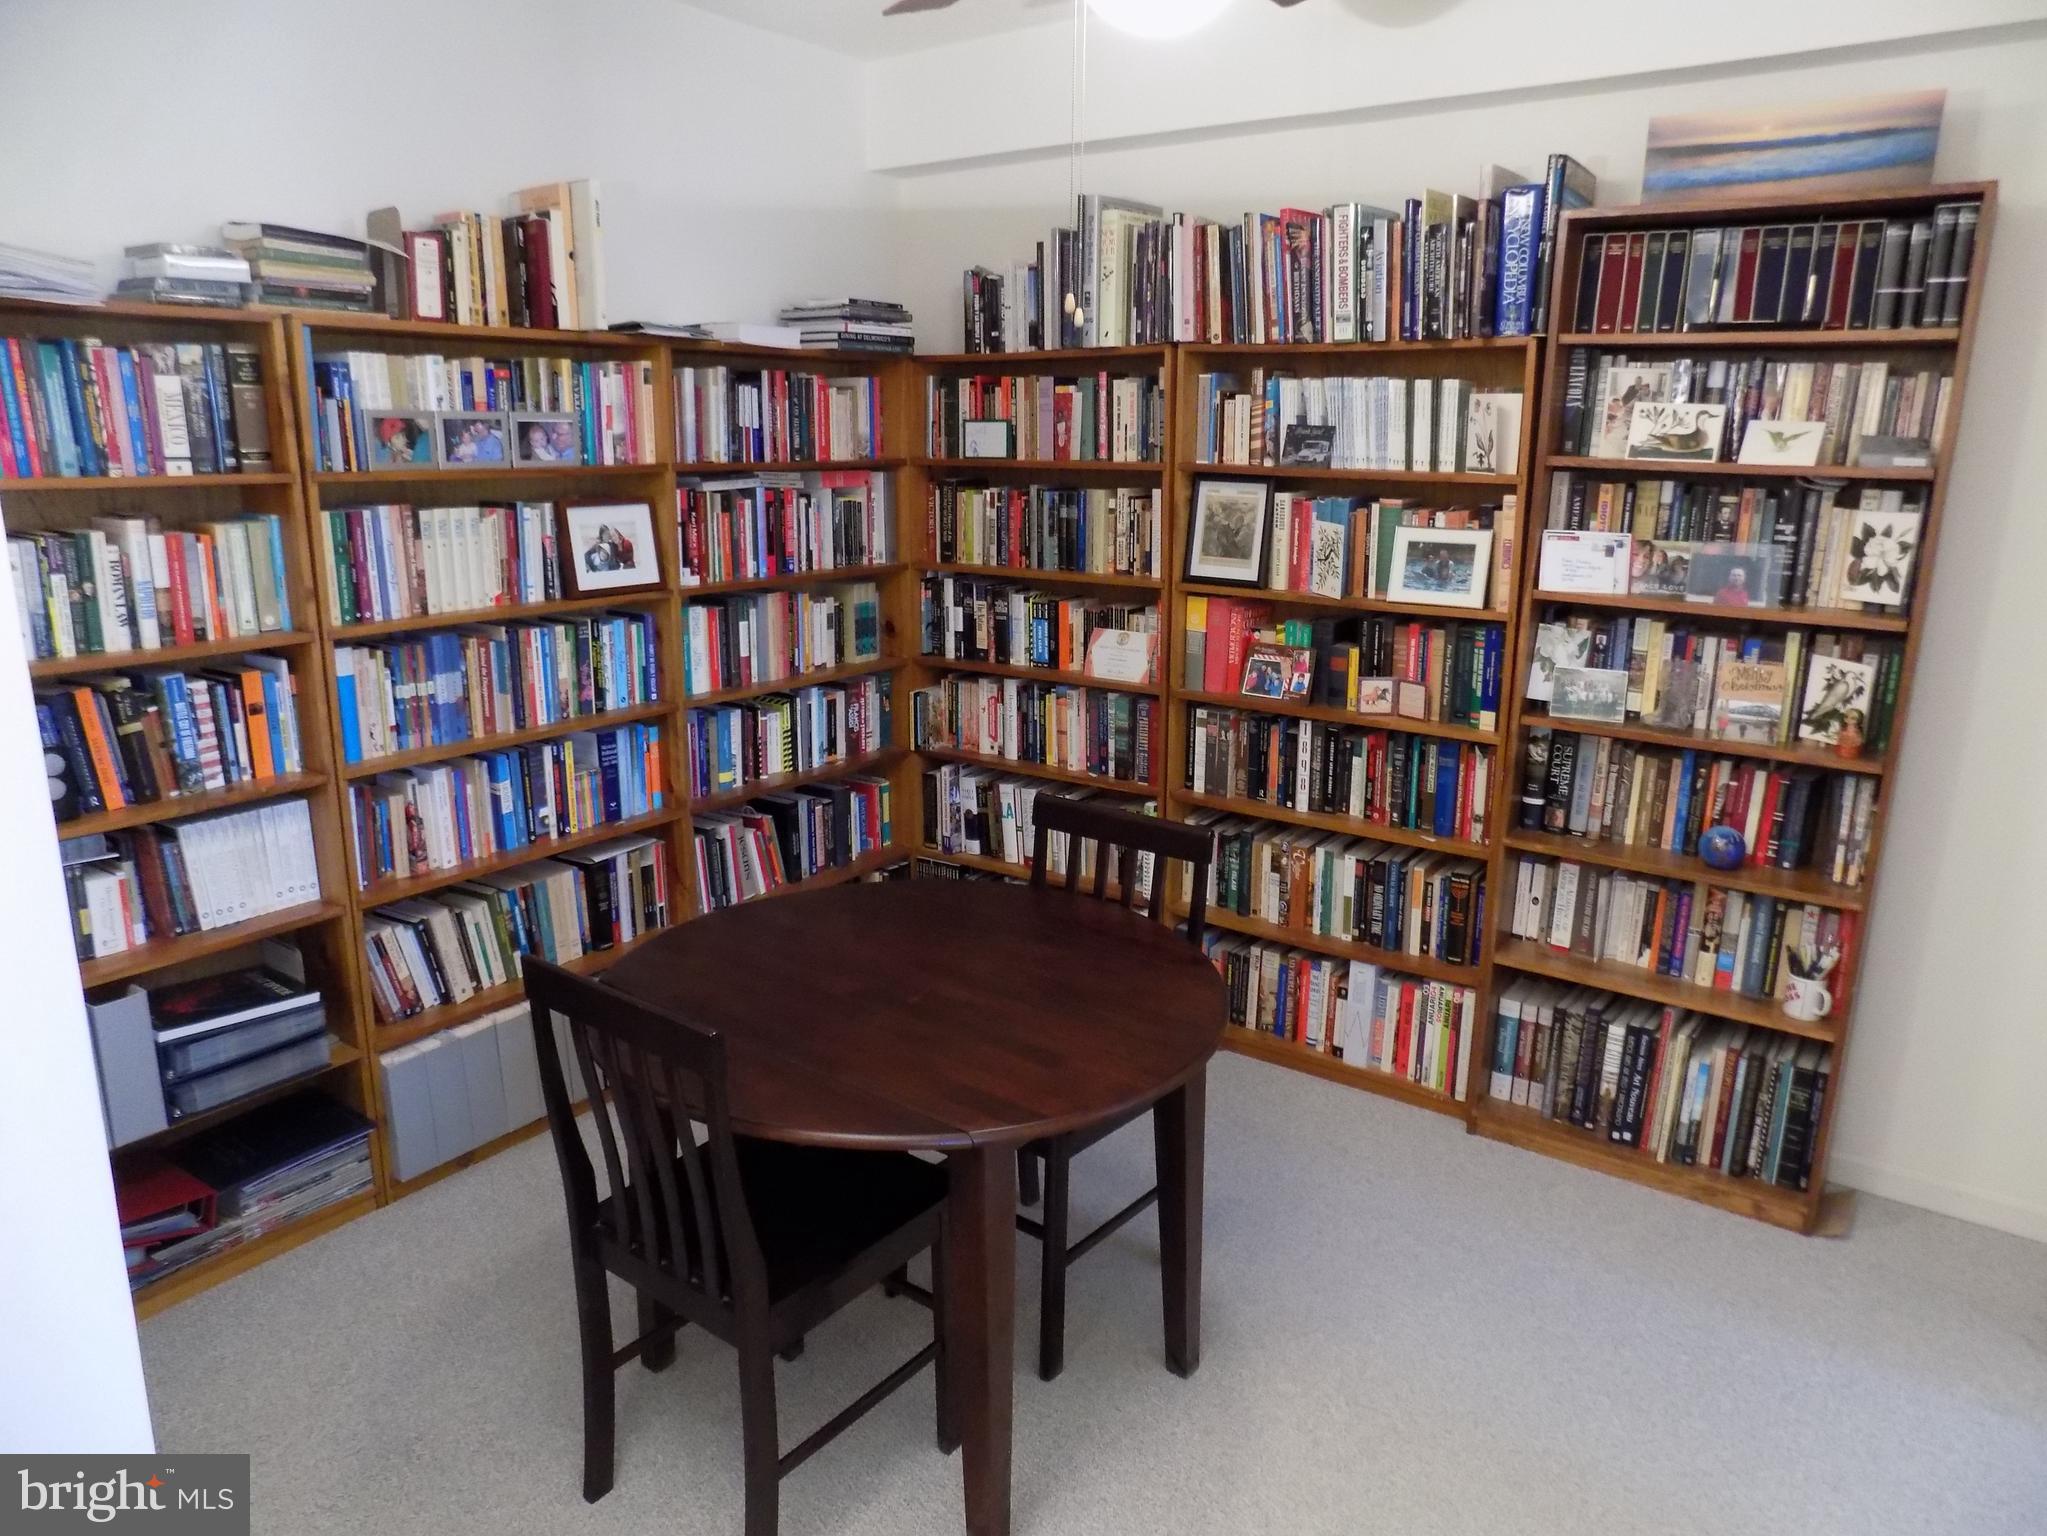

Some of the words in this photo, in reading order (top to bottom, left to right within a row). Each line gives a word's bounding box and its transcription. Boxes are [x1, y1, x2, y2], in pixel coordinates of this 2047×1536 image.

[1338, 214, 1349, 258] FIGHTERS
[1338, 267, 1349, 309] BOMBERS
[1375, 250, 1385, 295] Aviation
[1515, 247, 1530, 304] COLUMBIA
[164, 391, 186, 446] MEXICO
[109, 560, 125, 600] ROMAN
[116, 604, 129, 628] LAW
[1550, 744, 1563, 785] COURT
[1558, 746, 1573, 796] SUPREME
[1633, 1072, 1643, 1087] Art
[1625, 1087, 1640, 1123] Nouveau
